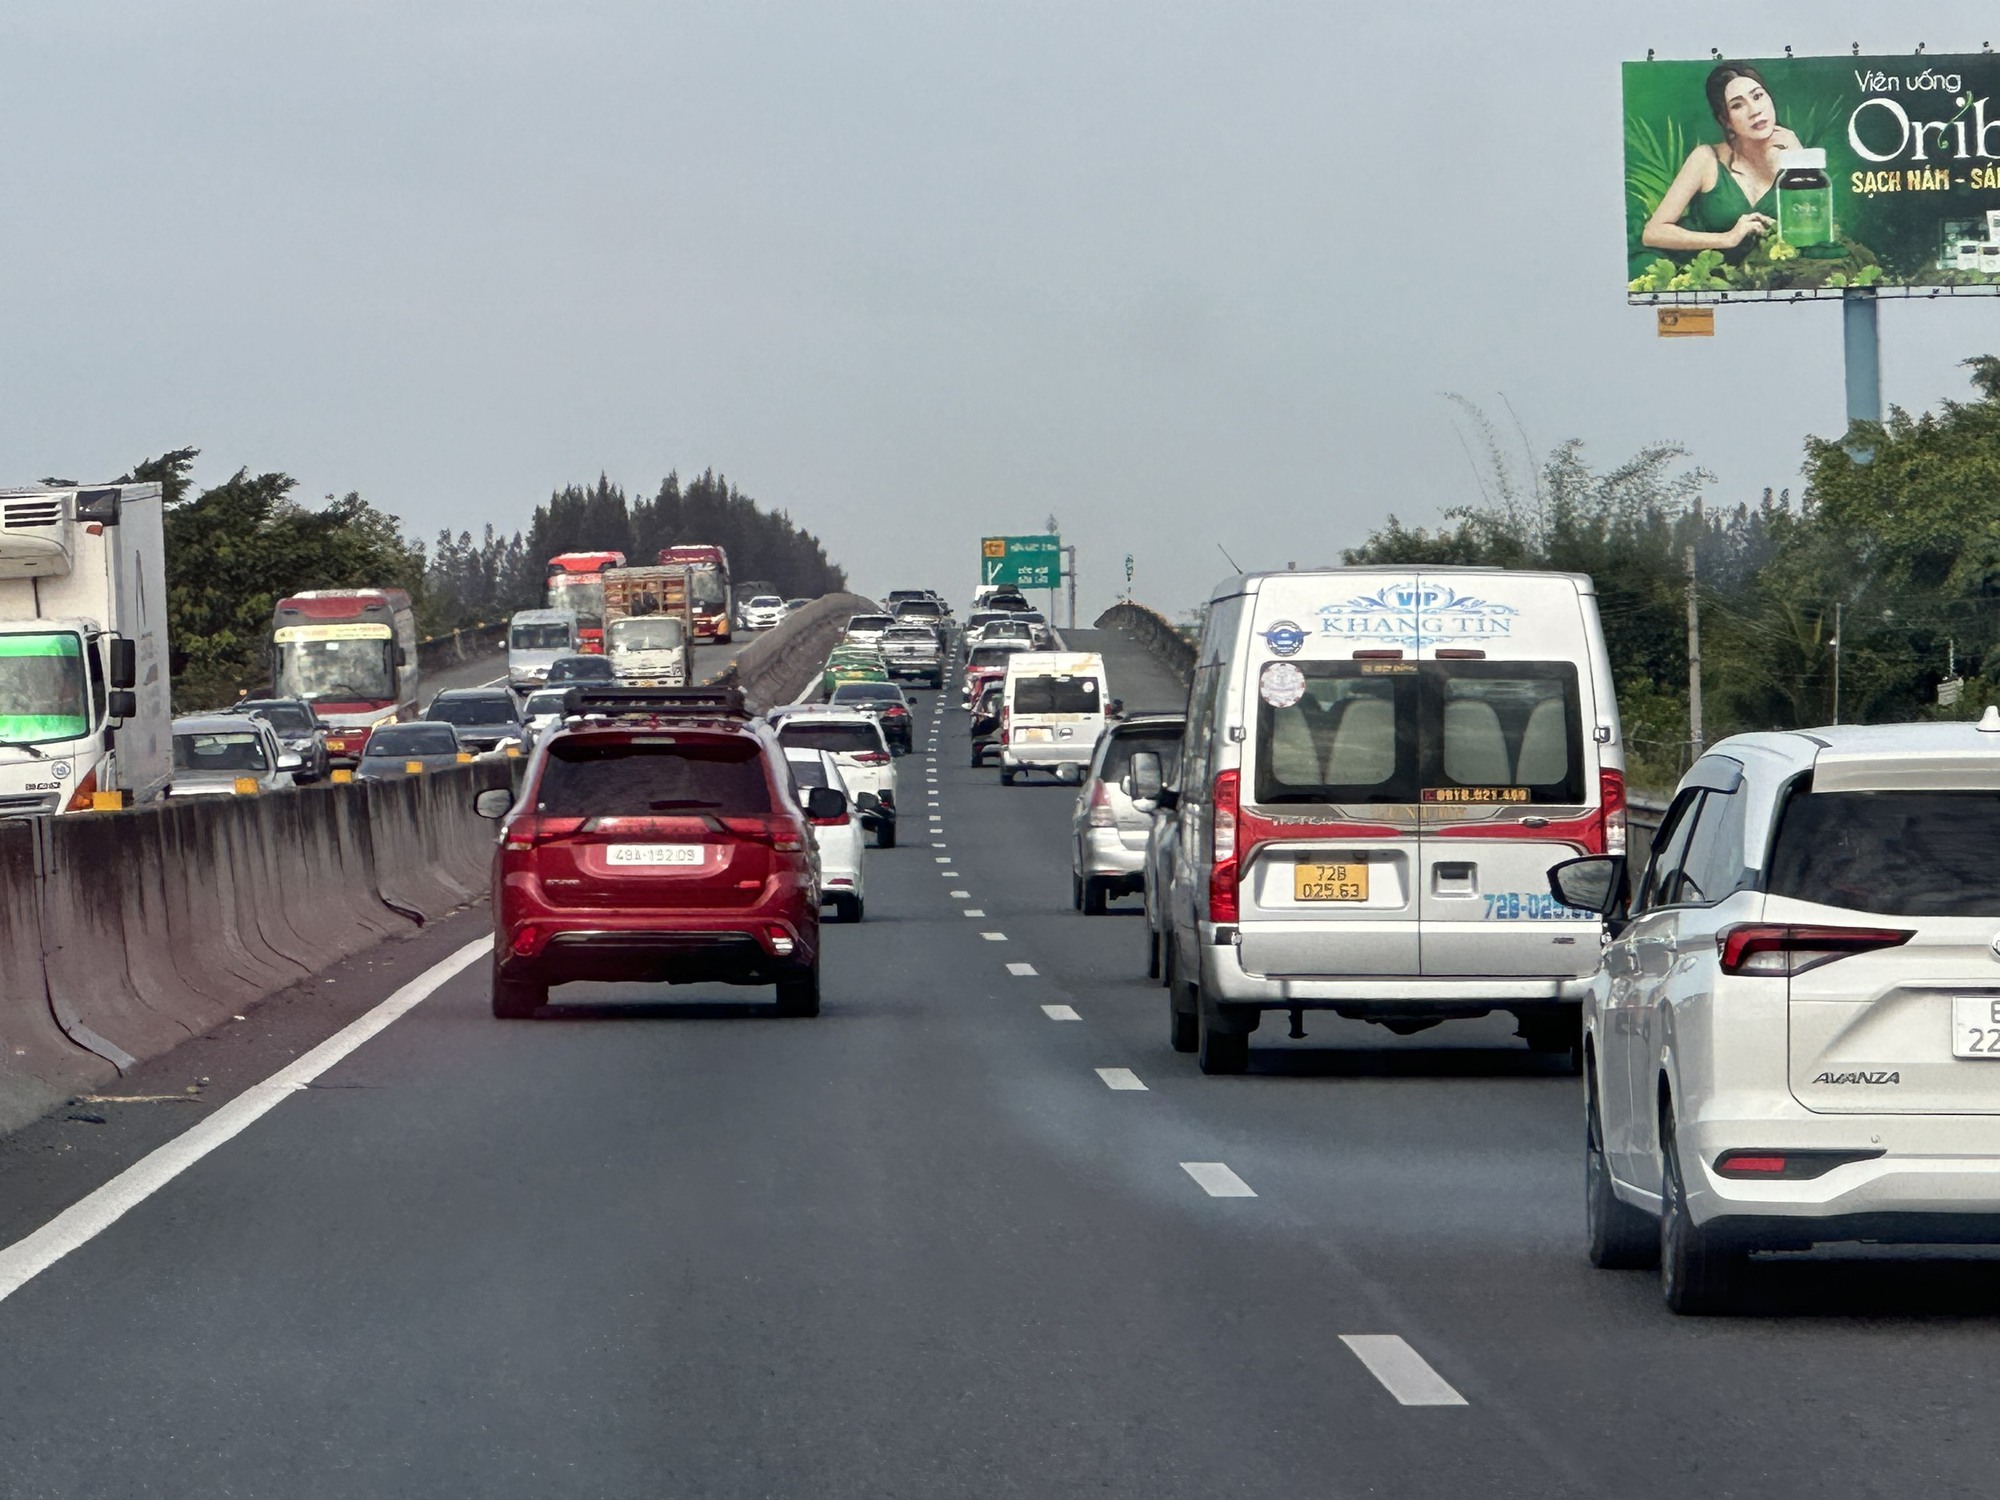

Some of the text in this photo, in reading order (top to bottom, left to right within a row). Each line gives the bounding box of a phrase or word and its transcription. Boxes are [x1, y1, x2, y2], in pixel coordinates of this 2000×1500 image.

[1854, 67, 1962, 94] Viên uống
[1851, 170, 1902, 199] SẠCH
[1970, 161, 2000, 189] SÁ
[1395, 591, 1439, 607] VIP
[1320, 617, 1443, 633] KHANG
[1315, 866, 1347, 881] 72B
[1811, 1071, 1901, 1085] AVANZA
